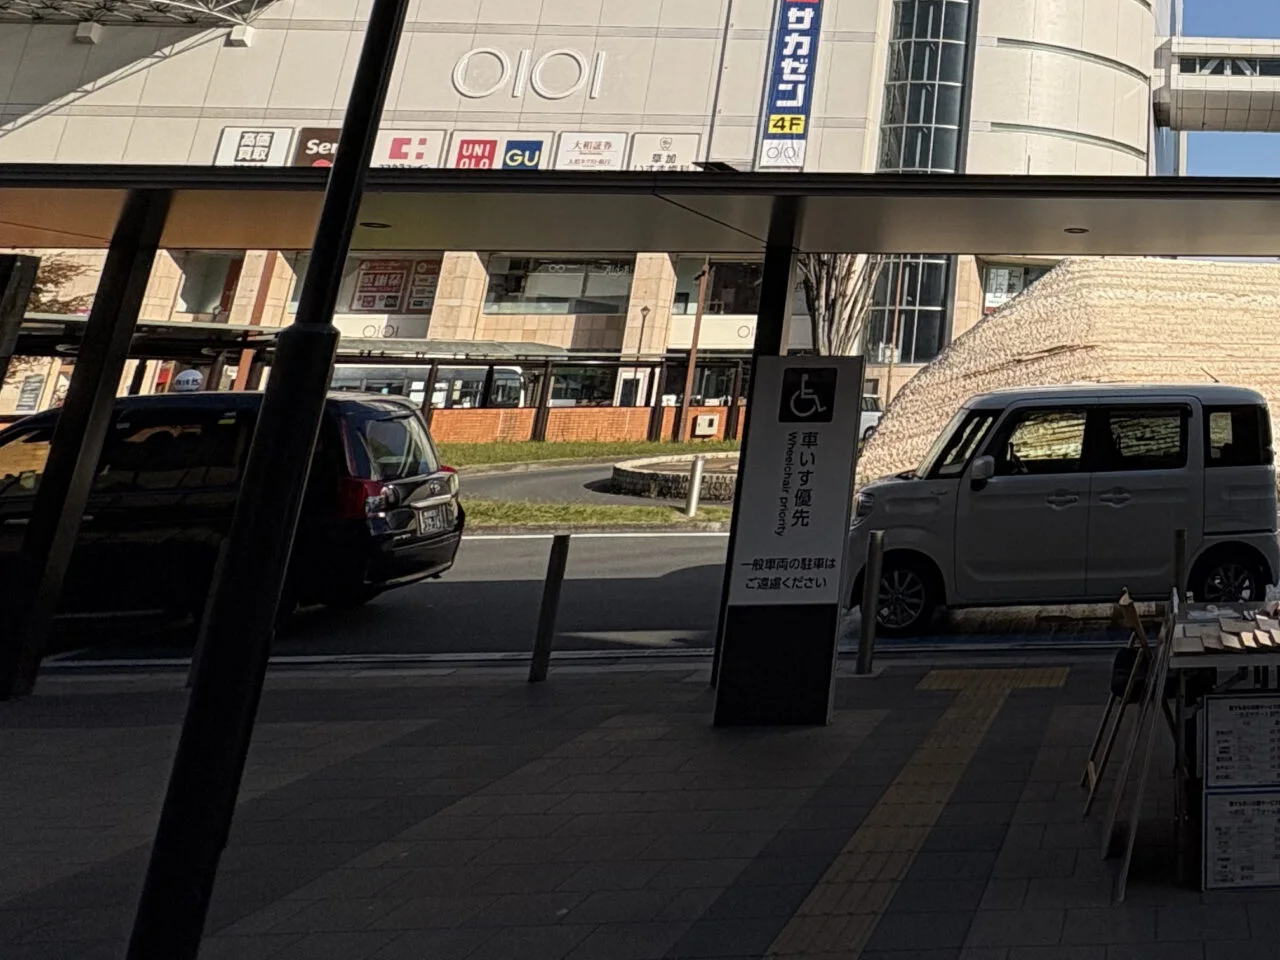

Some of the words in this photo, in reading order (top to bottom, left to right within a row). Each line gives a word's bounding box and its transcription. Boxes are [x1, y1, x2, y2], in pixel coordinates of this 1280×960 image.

[775, 6, 815, 109] サカゼン
[772, 116, 803, 132] 4F
[305, 139, 340, 155] Ser
[462, 144, 490, 157] UNI
[505, 149, 540, 167] GU
[781, 431, 798, 495] Wheelchair
[791, 431, 819, 528] 車いす優先
[774, 496, 793, 537] priority
[740, 557, 836, 572] 一般車両の駐車は
[745, 575, 827, 590] ご遠慮ください
